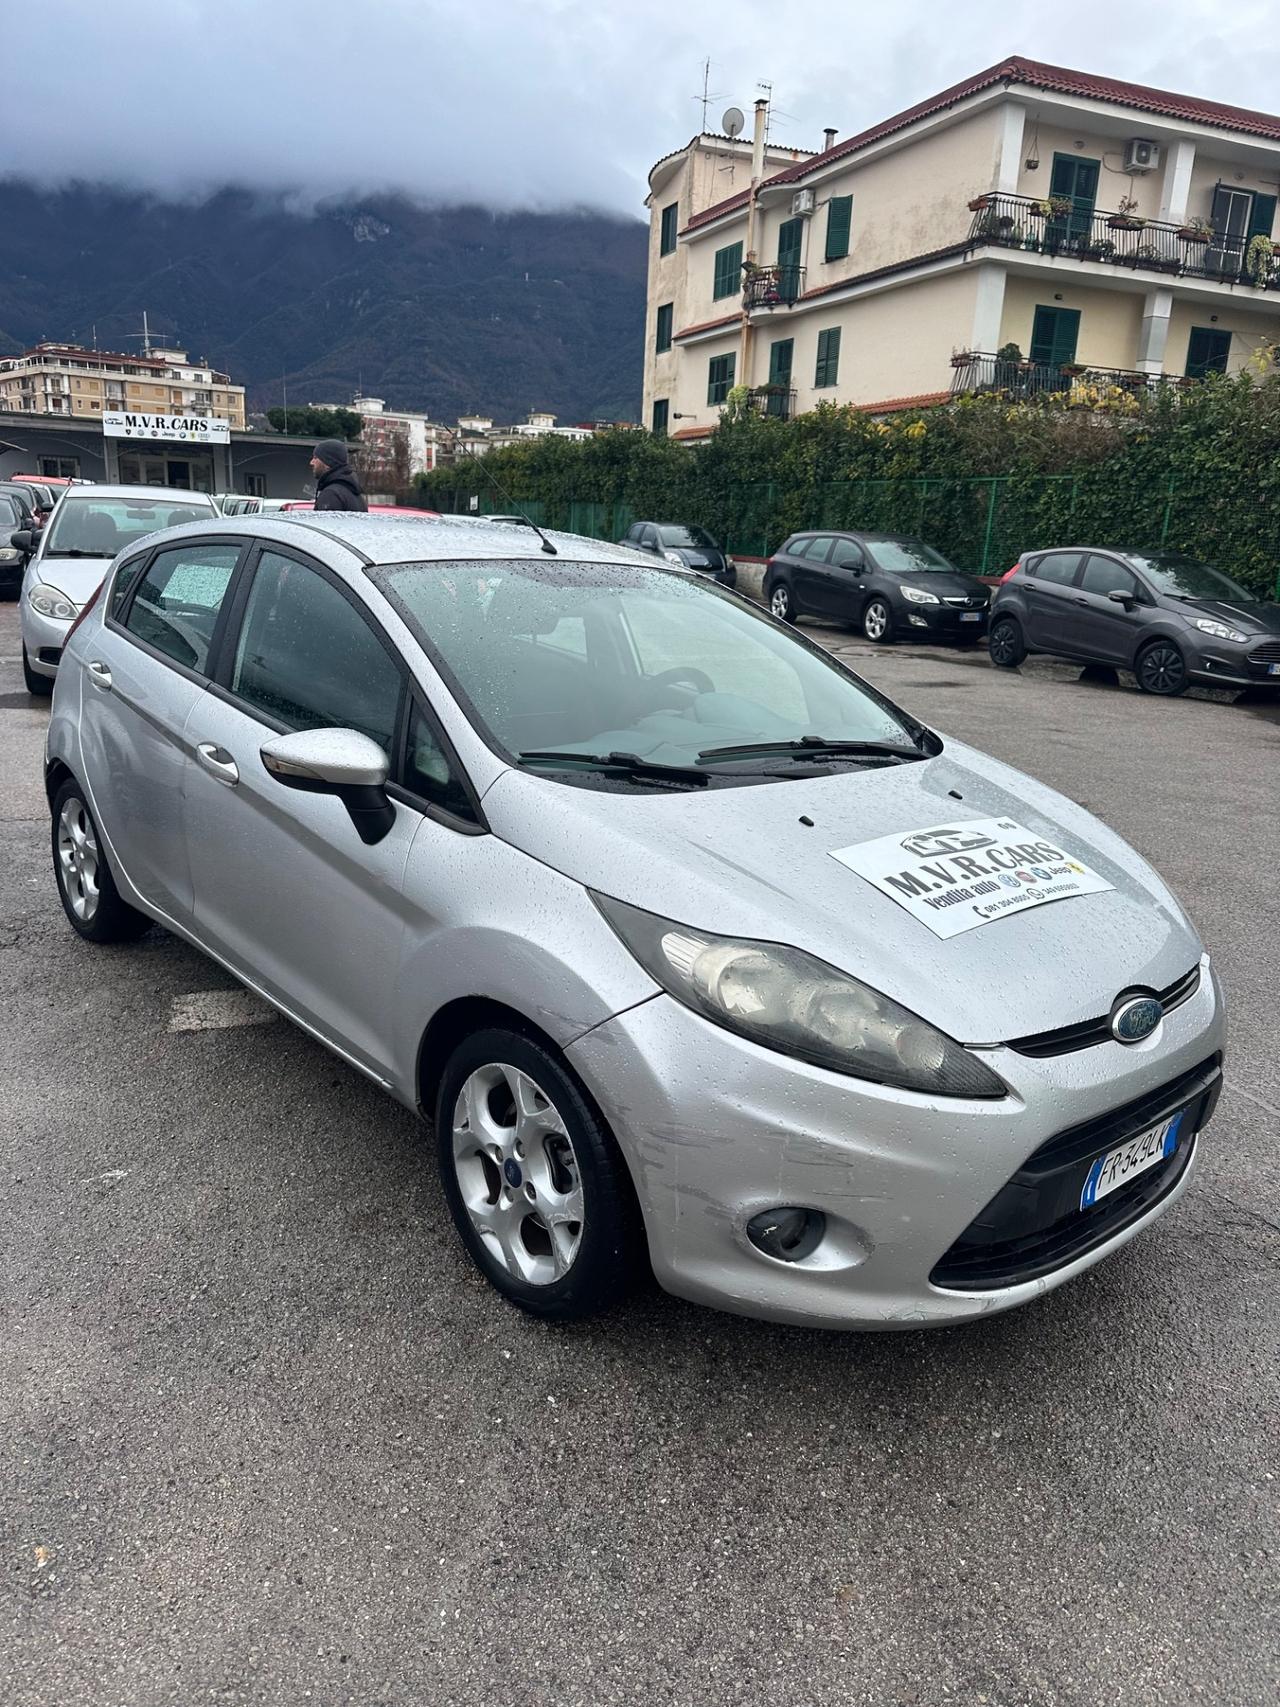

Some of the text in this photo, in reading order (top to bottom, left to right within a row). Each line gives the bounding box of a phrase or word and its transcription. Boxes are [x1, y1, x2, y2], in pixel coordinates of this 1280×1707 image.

[125, 415, 208, 432] M.V.R.CARS
[883, 841, 1065, 899] M.V.R.CARS
[1049, 866, 1072, 875] Jeep
[922, 879, 1000, 911] Vendita auto
[984, 903, 1000, 913] 081
[1128, 1006, 1157, 1034] Ford
